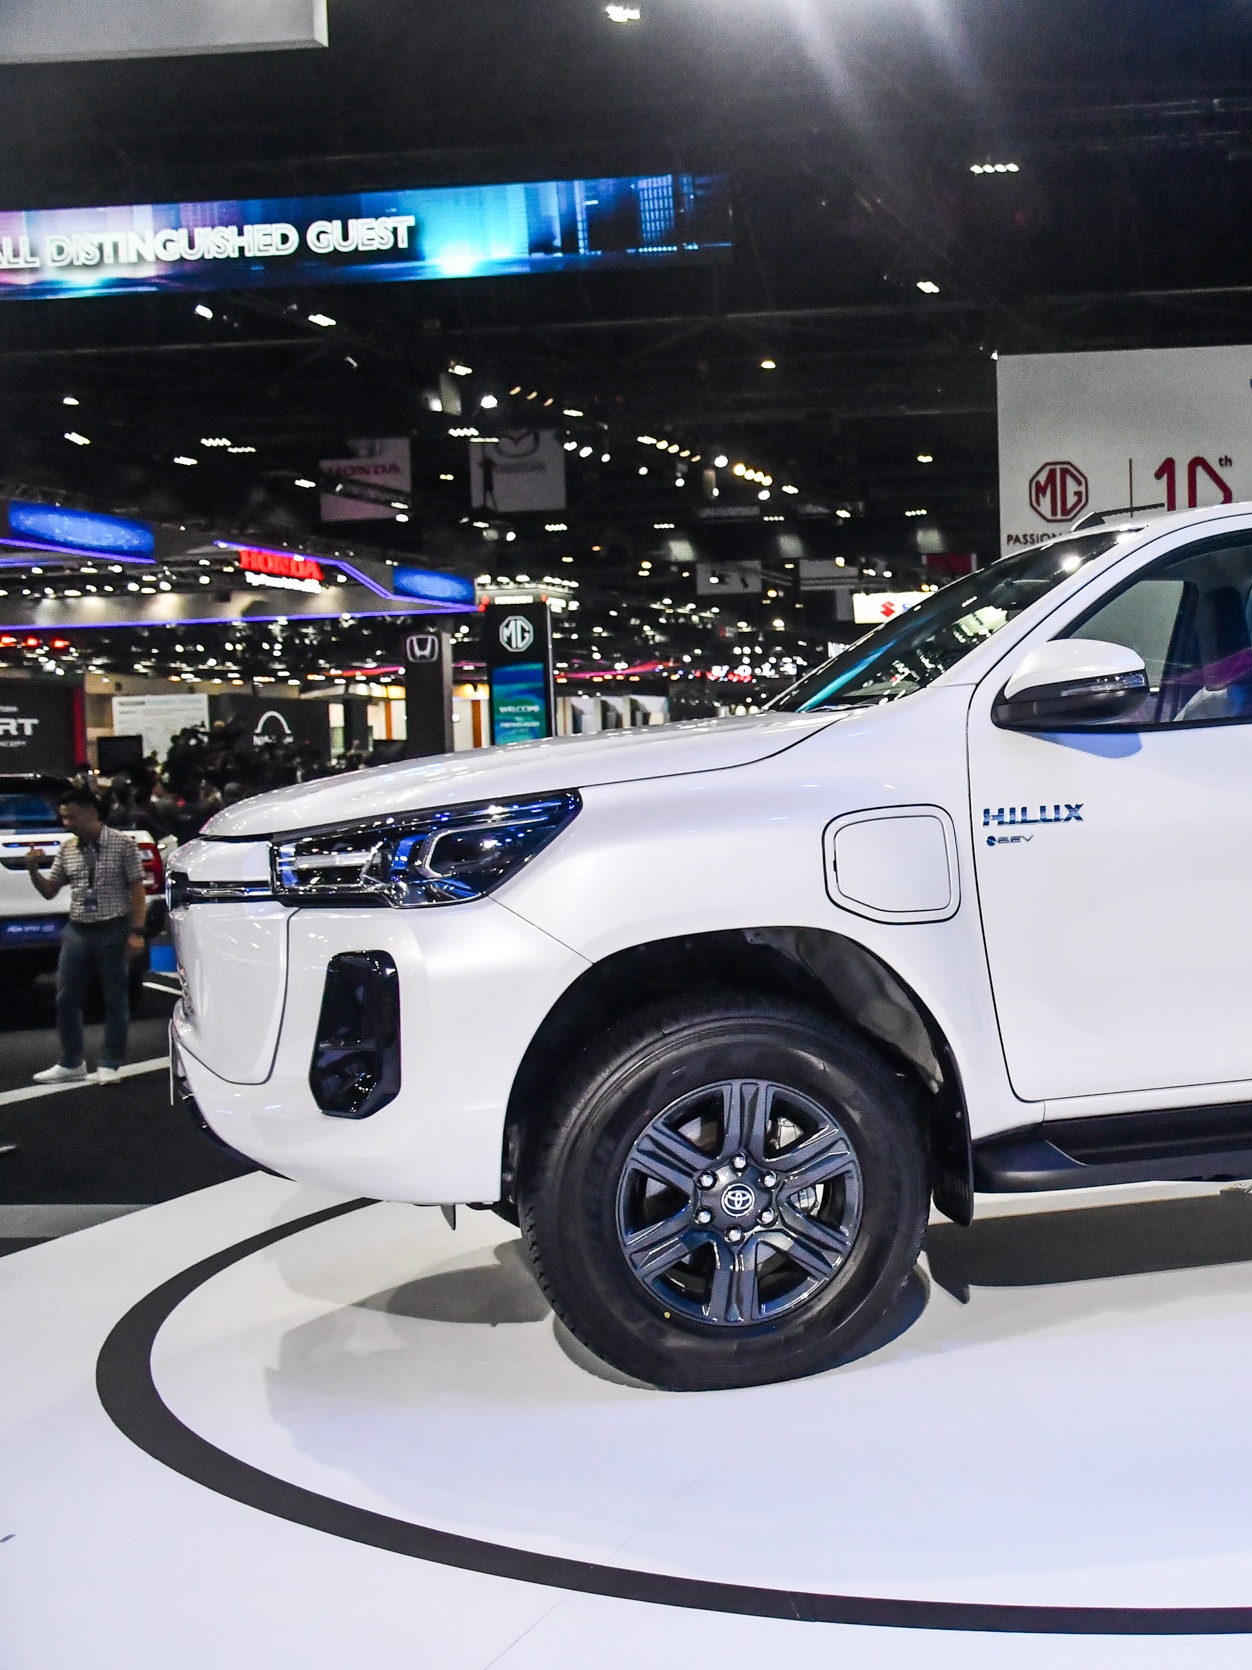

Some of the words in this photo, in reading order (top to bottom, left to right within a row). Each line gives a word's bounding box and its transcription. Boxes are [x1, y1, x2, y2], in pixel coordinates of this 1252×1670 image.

[47, 222, 300, 267] DISTINGUISHED
[306, 215, 416, 254] GUEST
[1033, 466, 1084, 518] MG
[502, 619, 531, 649] MG
[982, 803, 1084, 826] HILUX
